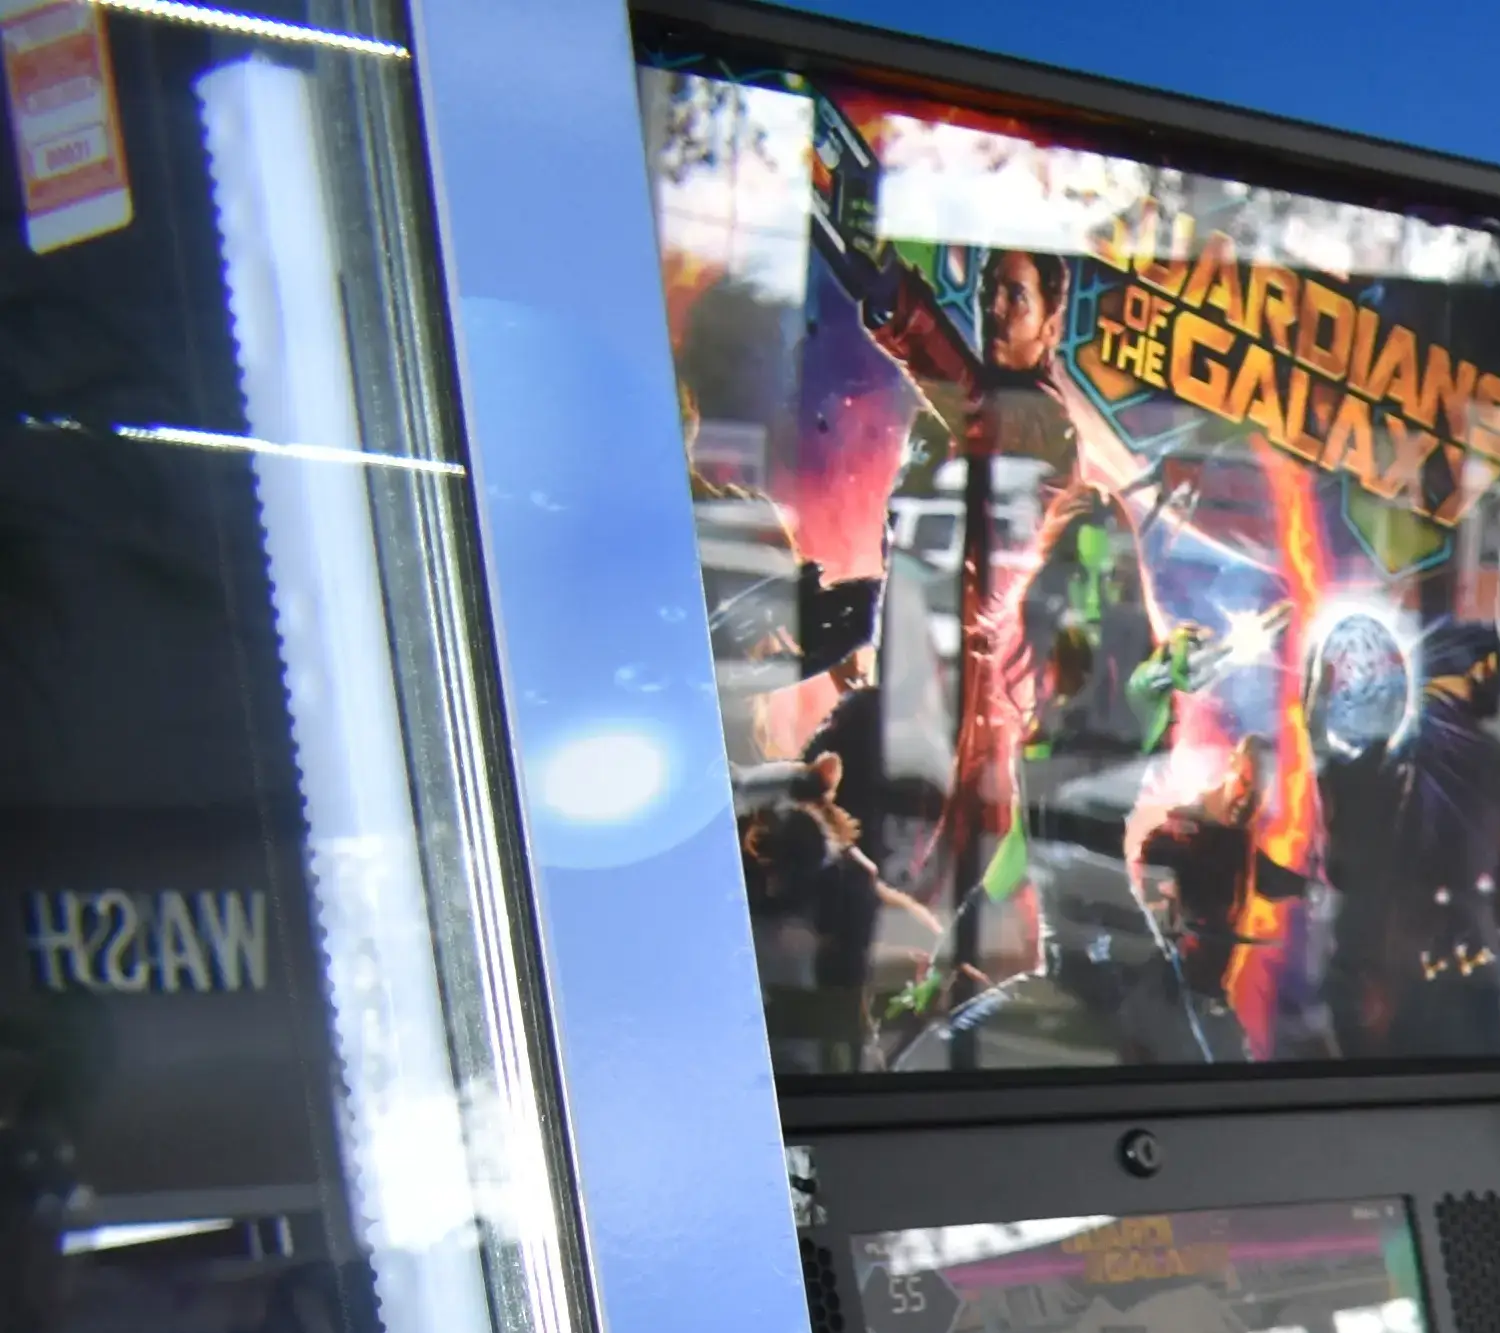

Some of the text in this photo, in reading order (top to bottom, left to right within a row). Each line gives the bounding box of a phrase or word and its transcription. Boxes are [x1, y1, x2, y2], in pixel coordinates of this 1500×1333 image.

[1124, 284, 1174, 338] OF
[1097, 311, 1500, 527] THE GALAXY
